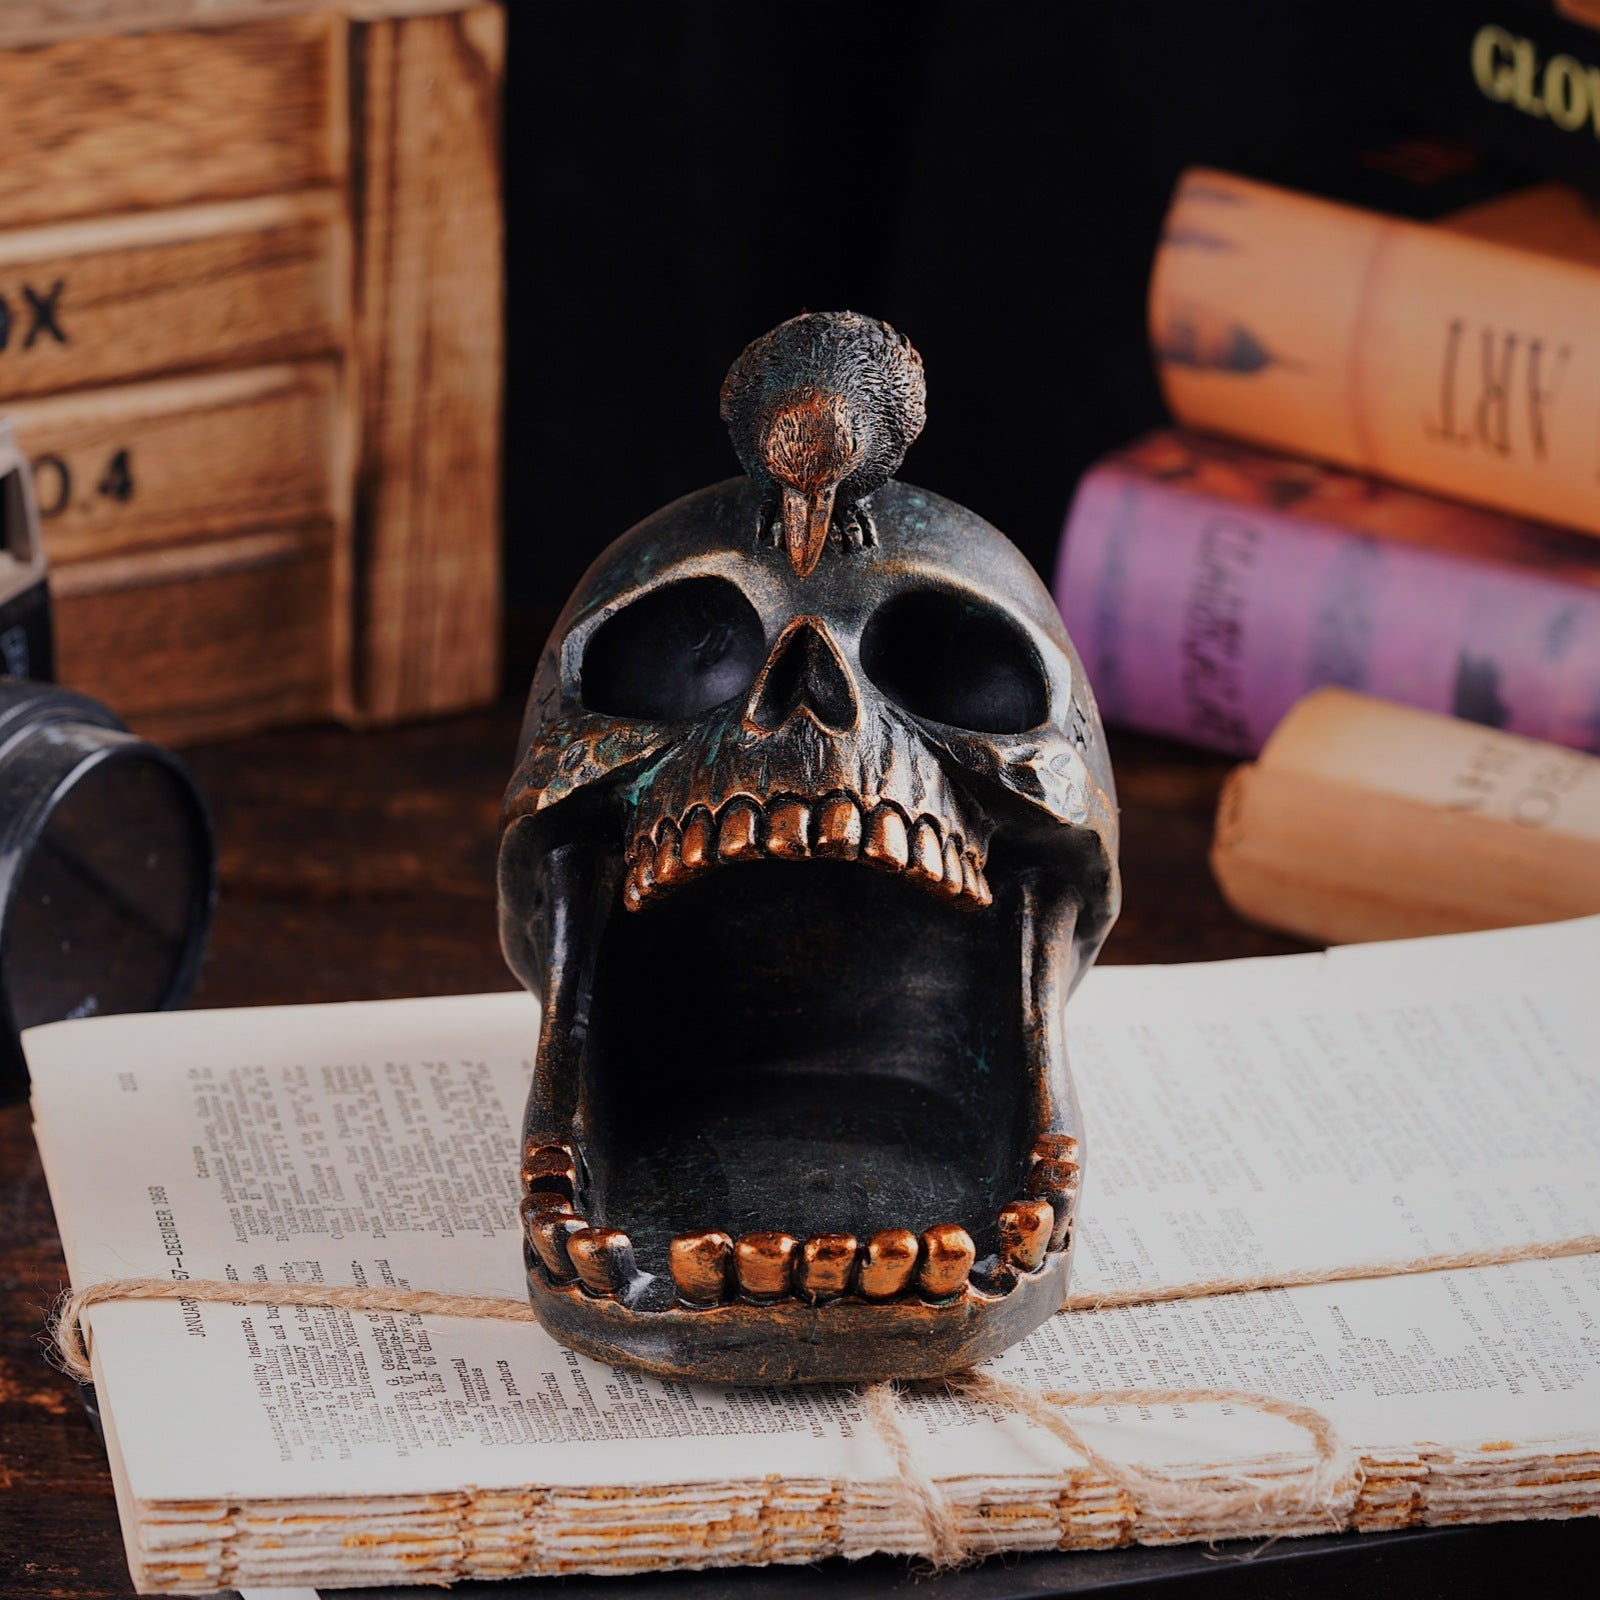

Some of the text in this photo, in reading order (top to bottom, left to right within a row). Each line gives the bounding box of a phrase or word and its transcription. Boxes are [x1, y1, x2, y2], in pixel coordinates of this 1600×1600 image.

[1423, 316, 1572, 464] ART
[151, 1209, 192, 1280] 67—DECEMBER
[222, 1263, 239, 1280] sur-
[249, 1263, 270, 1282] uide,
[372, 1258, 396, 1286] ustrial
[176, 1295, 207, 1337] JANUARY
[268, 1324, 287, 1339] and
[298, 1326, 316, 1340] and
[1168, 1314, 1200, 1350] problems
[1201, 1310, 1233, 1348] processes
[1456, 1308, 1483, 1331] under
[369, 1327, 396, 1370] Geography
[379, 1315, 410, 1370] Prentice-Hall
[1014, 1337, 1039, 1360] Indus
[1028, 1331, 1061, 1375] developme
[1088, 1321, 1119, 1355] methods
[1323, 1305, 1390, 1396] Finishes and finishing
[1356, 1337, 1380, 1356] tools
[1406, 1327, 1437, 1355] control
[260, 1347, 286, 1380] liability
[289, 1345, 317, 1387] Littlebury
[304, 1344, 329, 1385] chemicals
[321, 1354, 346, 1389] building
[405, 1349, 422, 1364] and
[1054, 1358, 1080, 1383] of W.
[1295, 1330, 1344, 1391] processes and
[1372, 1338, 1417, 1394] Manufactures
[1397, 1354, 1431, 1392] Materials
[1473, 1335, 1525, 1394] Manufacturing
[248, 1363, 276, 1397] liability
[384, 1376, 400, 1385] G.
[412, 1370, 428, 1380] H.
[417, 1387, 432, 1396] R.
[427, 1372, 447, 1392] $5.25
[449, 1357, 480, 1407] Commercial
[469, 1367, 492, 1401] watches
[539, 1371, 568, 1409] Industrial
[270, 1384, 297, 1422] Products
[317, 1390, 333, 1398] of
[333, 1394, 350, 1408] the
[349, 1391, 365, 1410] voor
[422, 1401, 438, 1410] C.
[449, 1399, 468, 1415] also
[480, 1404, 499, 1417] and
[493, 1359, 537, 1442] Commercial products
[559, 1350, 610, 1439] Glass manufacture and
[599, 1384, 639, 1438] Industrial arts
[632, 1387, 658, 1417] industry
[339, 1413, 355, 1424] for
[498, 1406, 523, 1443] Commerce
[521, 1397, 553, 1442] Competition
[534, 1391, 567, 1442] Confectionery
[569, 1406, 596, 1441] Factories
[600, 1410, 624, 1439] Hosiery
[624, 1402, 653, 1438] Industrial
[652, 1398, 683, 1437] Machinery
[688, 1413, 710, 1436] Paper
[700, 1406, 724, 1435] Patents
[716, 1410, 739, 1434] Prices
[721, 1391, 751, 1433] Production
[735, 1391, 766, 1433] Production
[771, 1409, 795, 1432] Trade
[648, 1421, 667, 1438] Iron
